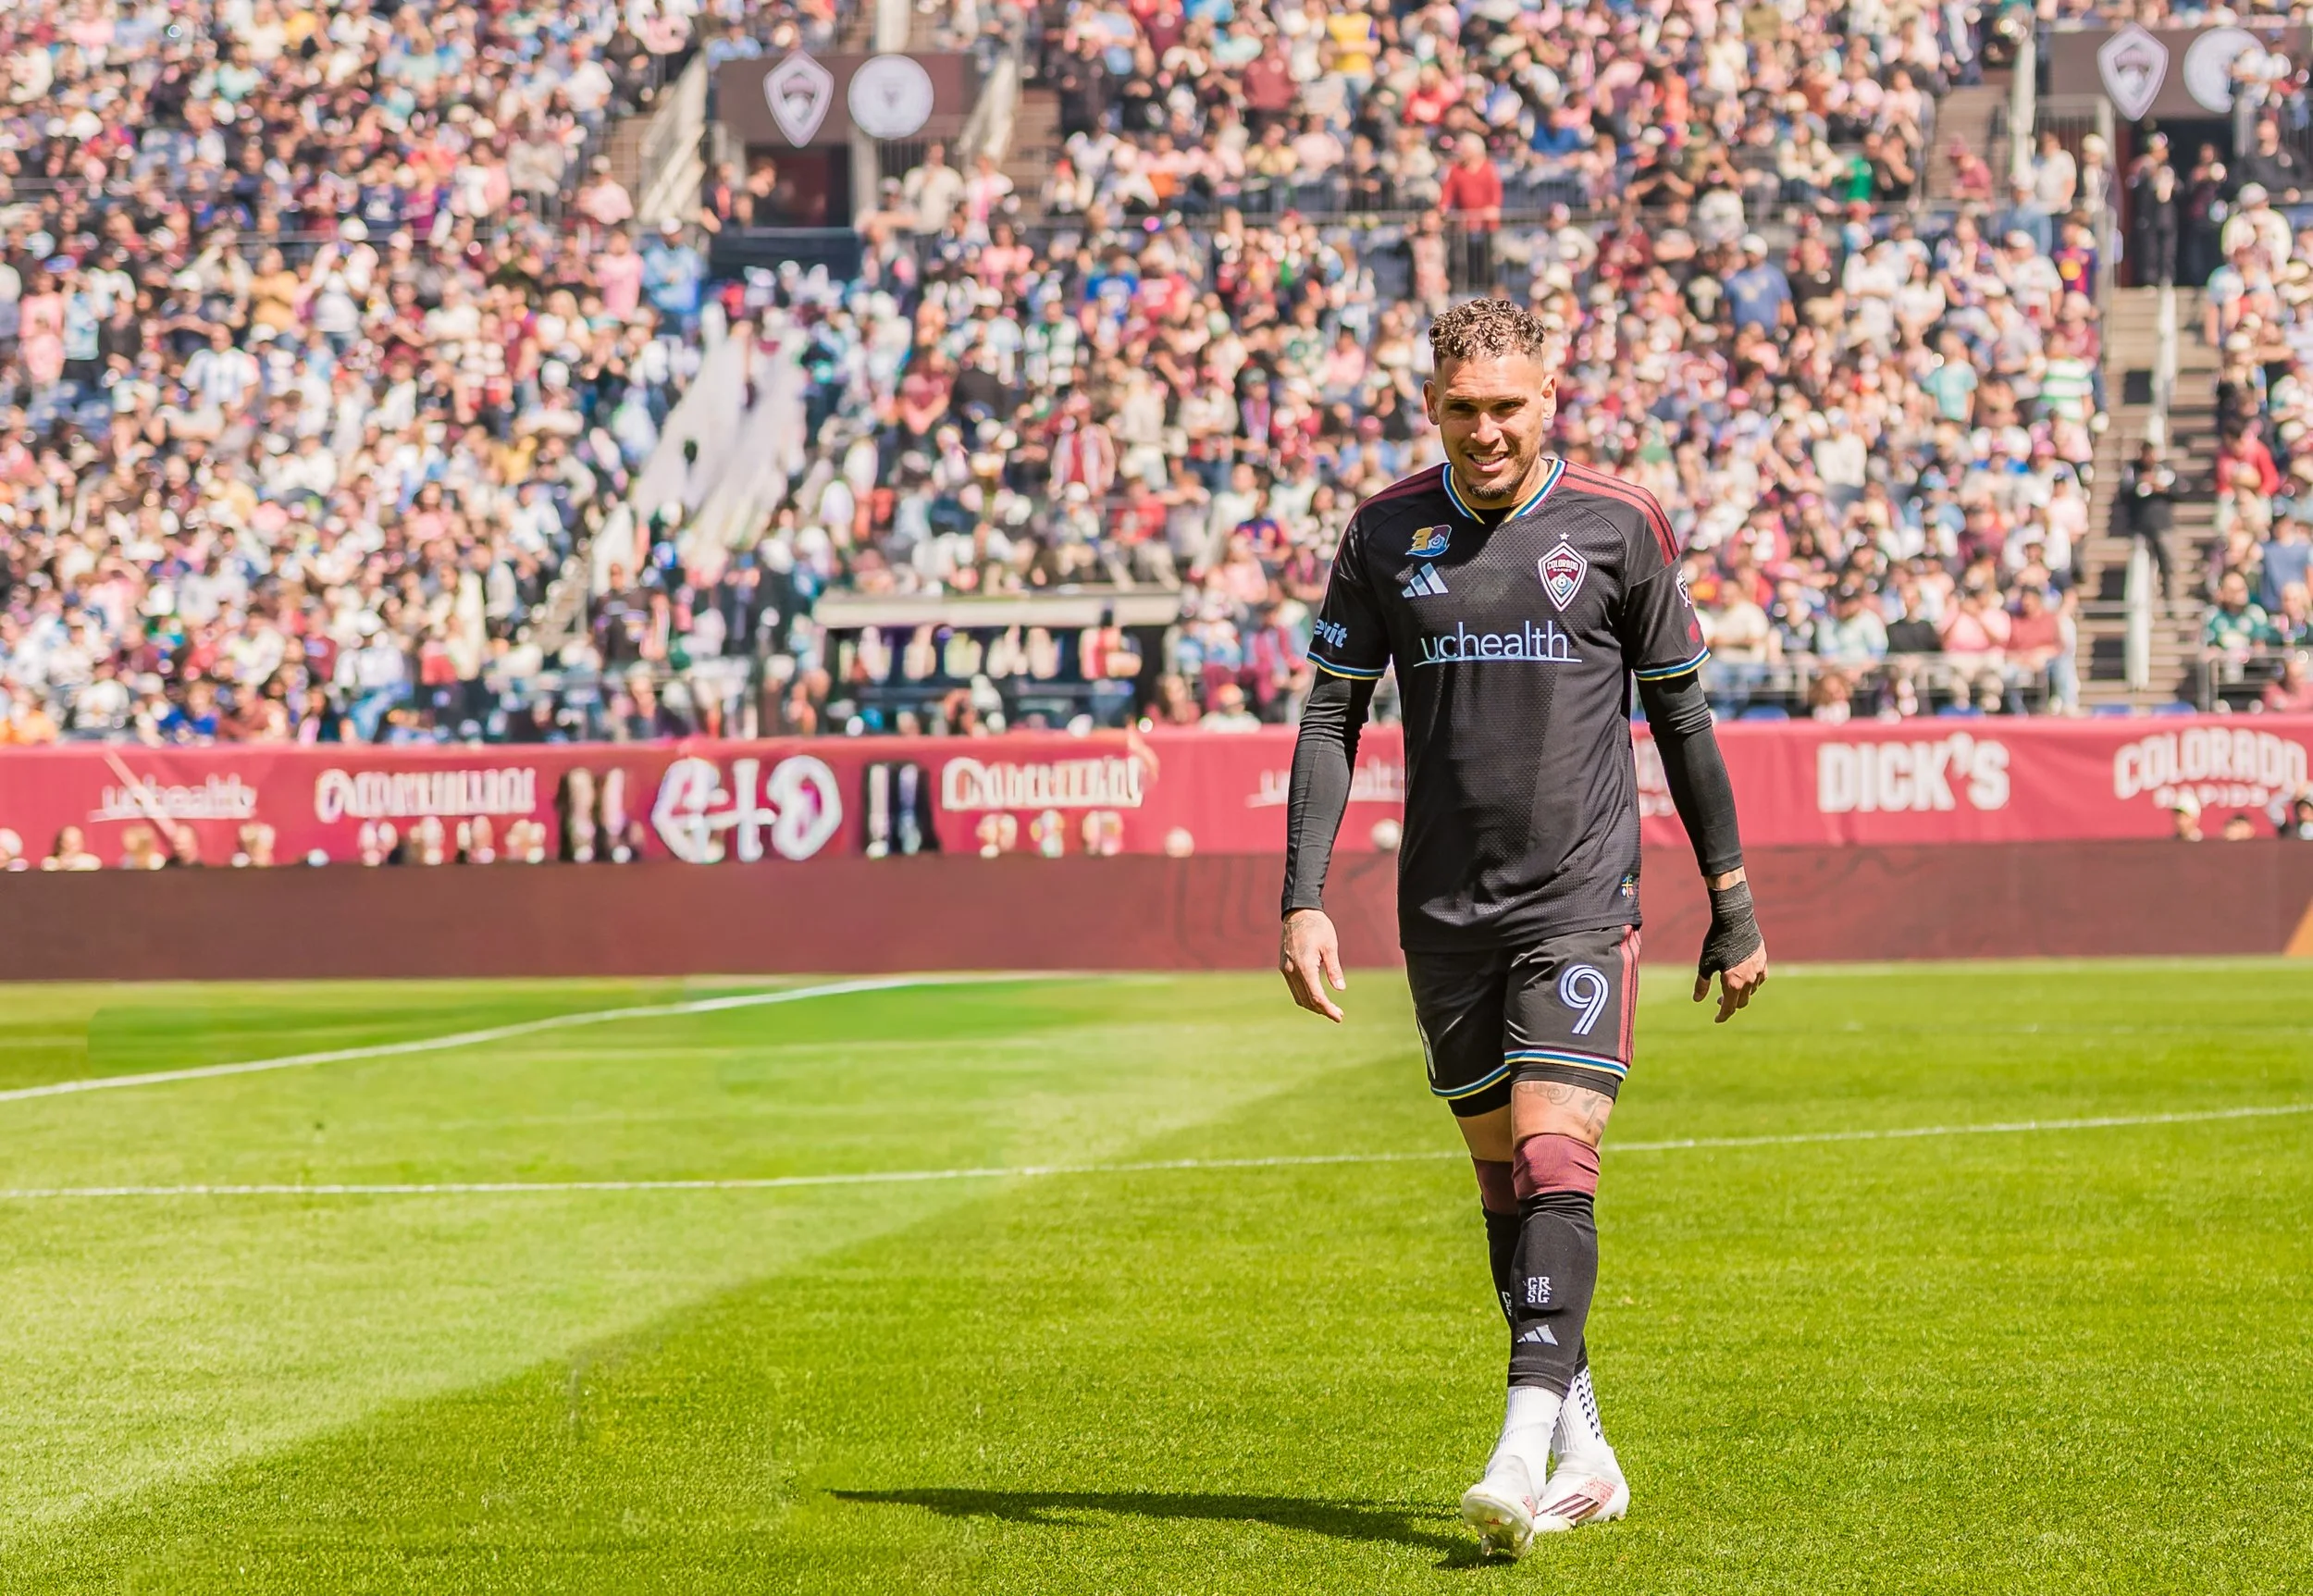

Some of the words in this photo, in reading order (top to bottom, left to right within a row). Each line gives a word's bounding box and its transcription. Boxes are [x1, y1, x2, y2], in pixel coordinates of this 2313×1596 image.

[1416, 620, 1573, 662] uchealth
[1816, 730, 2011, 814] DICK'S
[2114, 726, 2307, 800] COLORADO
[1559, 964, 1610, 1036] 9
